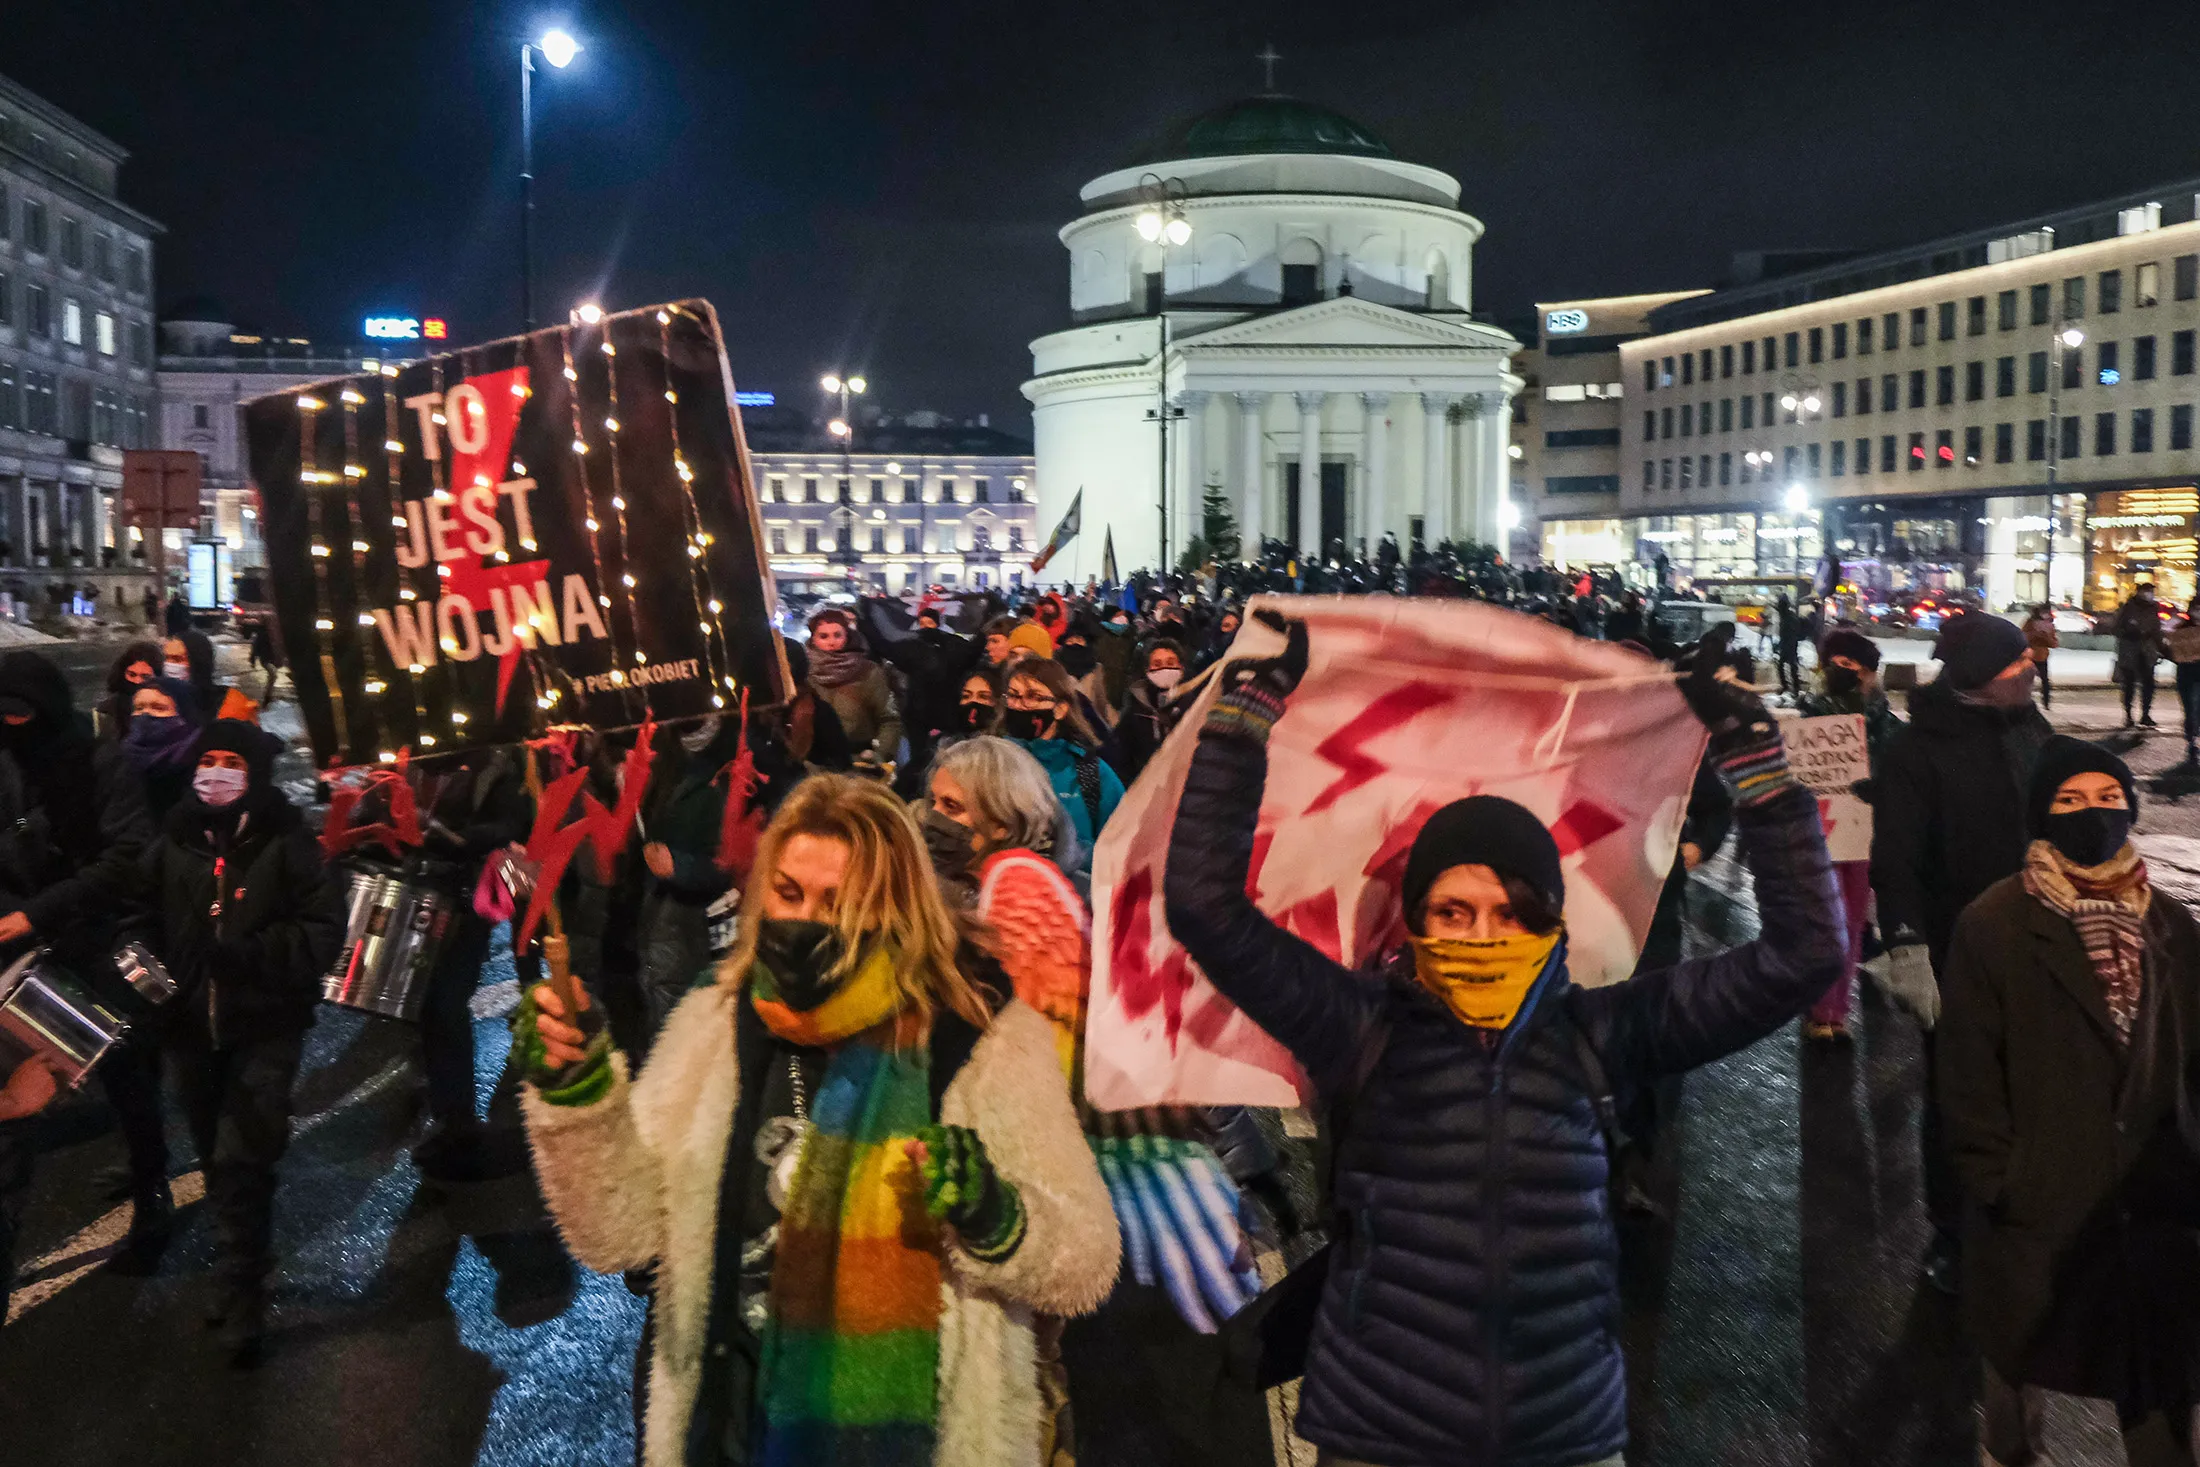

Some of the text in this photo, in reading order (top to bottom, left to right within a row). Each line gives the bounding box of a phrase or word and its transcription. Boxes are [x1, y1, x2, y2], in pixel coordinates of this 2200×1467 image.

[404, 384, 488, 460] TO
[396, 477, 538, 568] JEST
[372, 573, 608, 670] WOJNA
